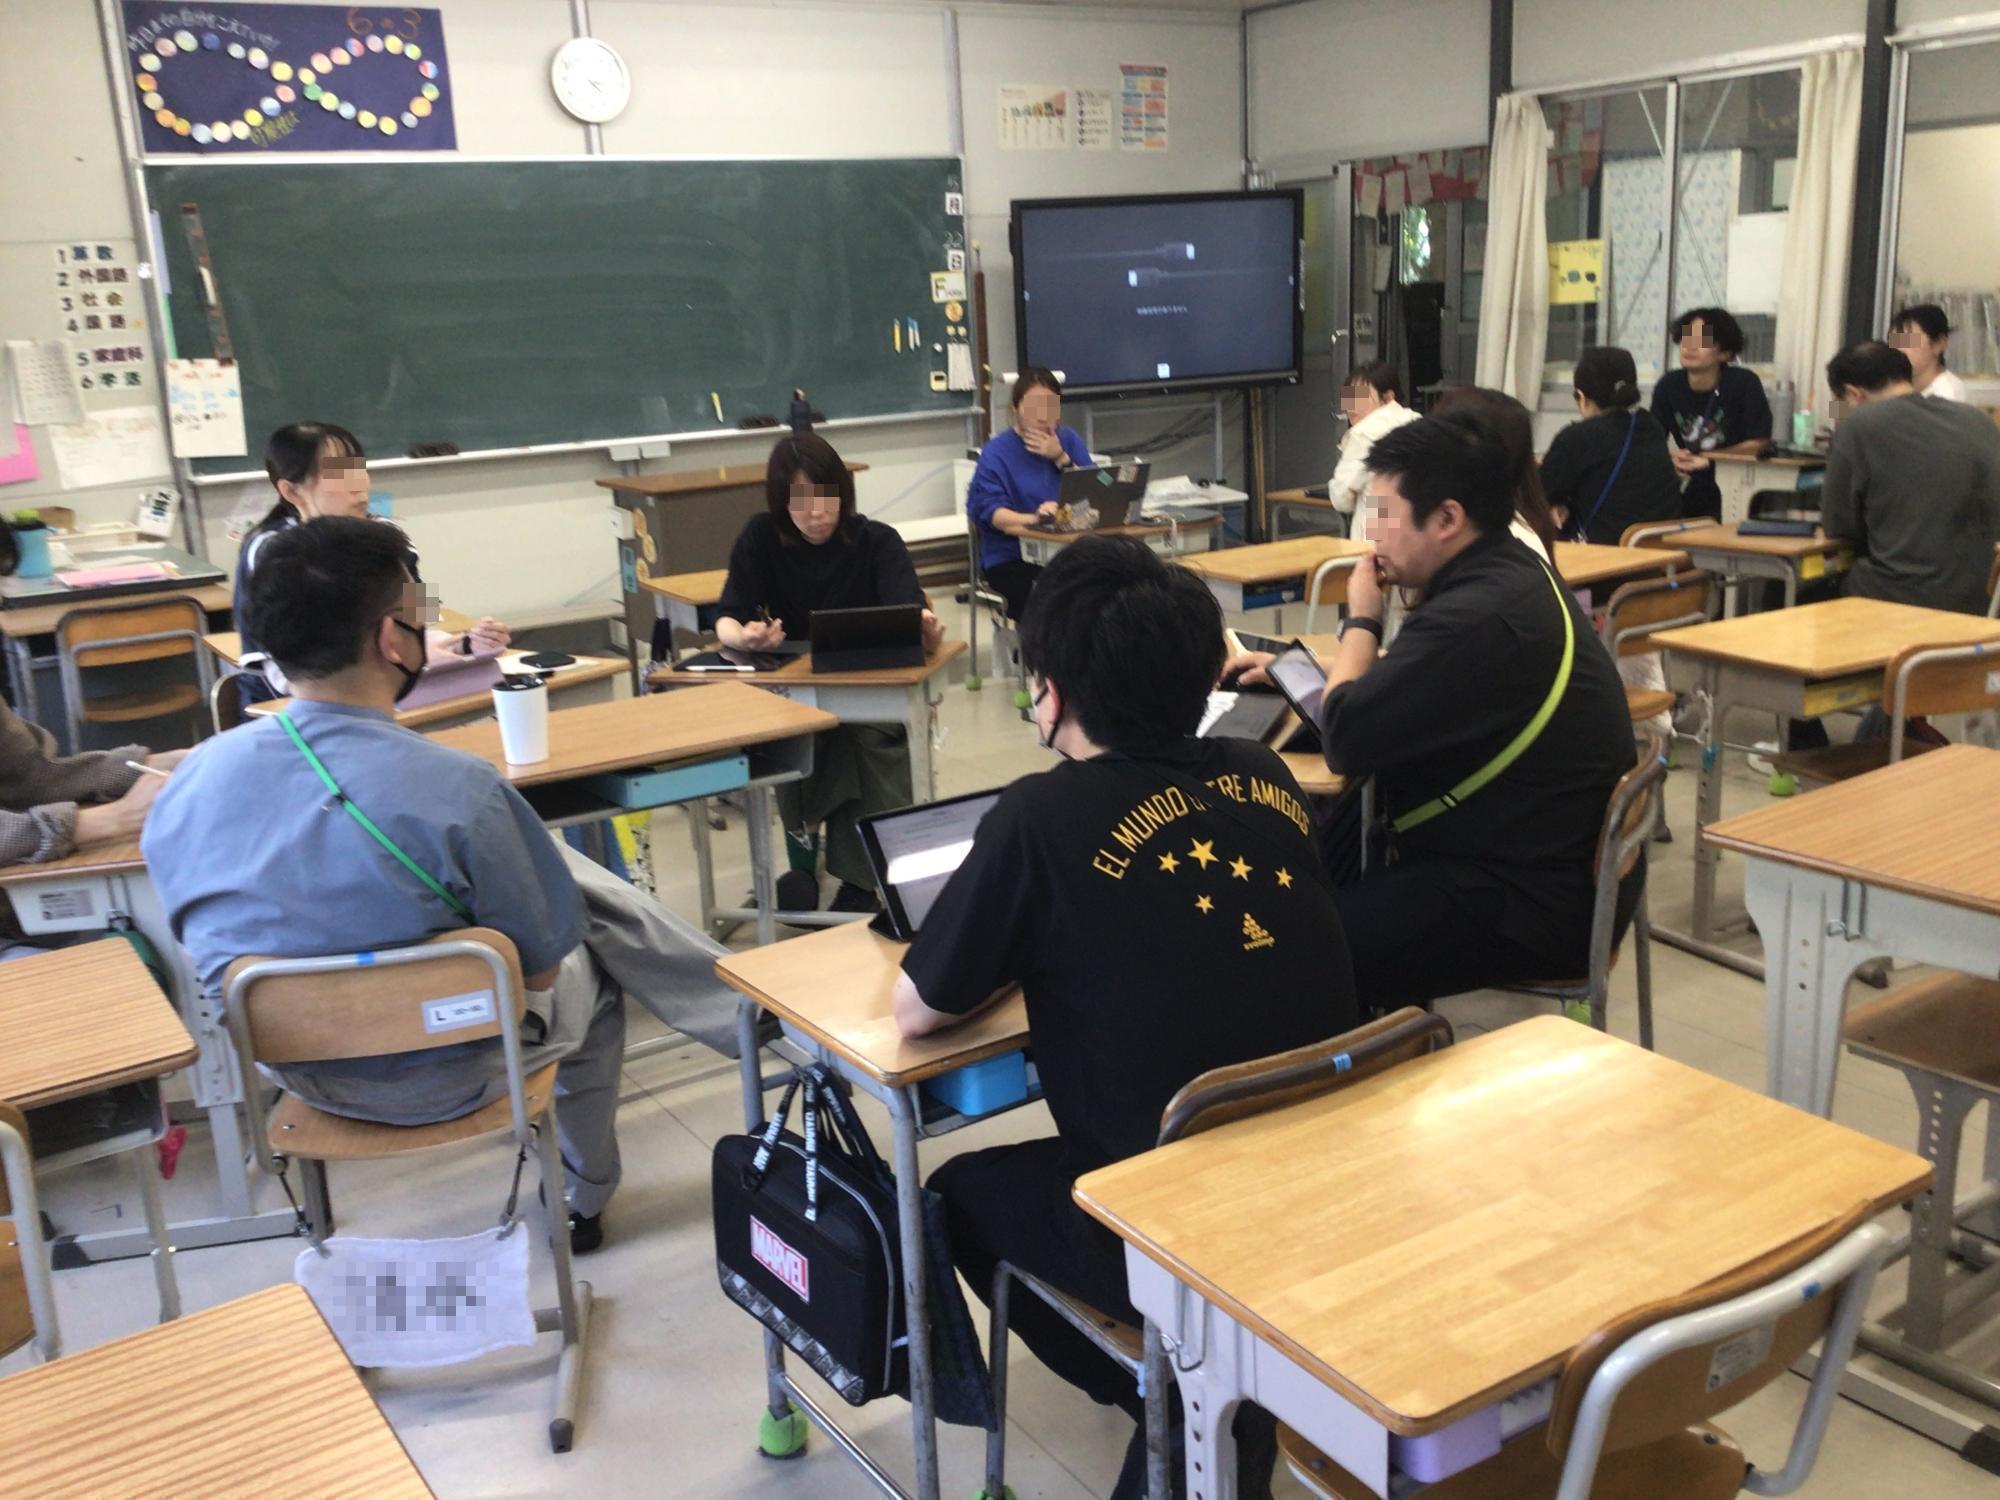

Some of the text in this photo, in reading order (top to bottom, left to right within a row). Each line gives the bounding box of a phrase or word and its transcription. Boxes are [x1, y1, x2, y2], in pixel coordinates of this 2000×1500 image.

[57, 272, 69, 287] 2
[61, 296, 72, 312] 3
[68, 319, 78, 333] 4
[77, 351, 89, 366] 5
[80, 374, 93, 390] 6
[1251, 775, 1310, 837] AMIGOS
[1111, 785, 1189, 853] MUNDO
[1092, 848, 1131, 880] EL
[751, 1220, 809, 1299] MARVEL
